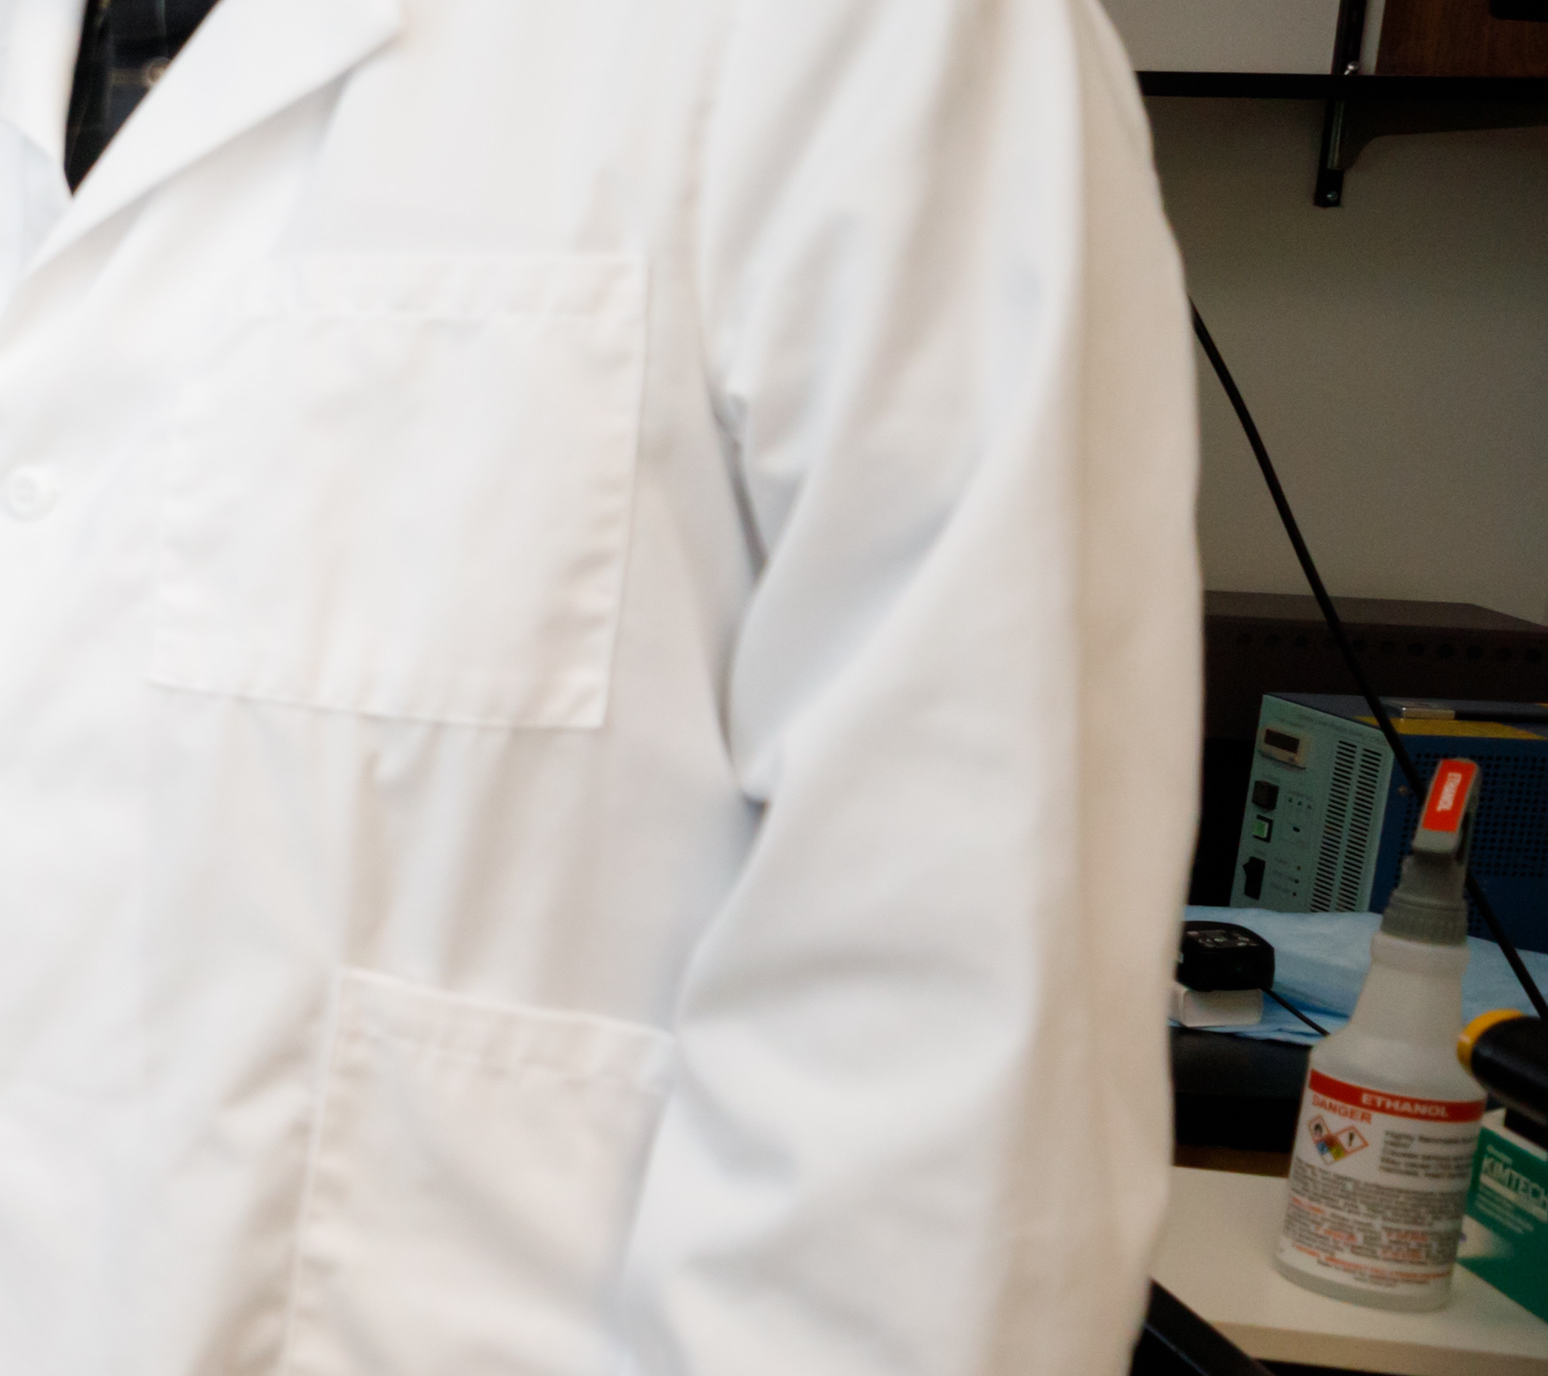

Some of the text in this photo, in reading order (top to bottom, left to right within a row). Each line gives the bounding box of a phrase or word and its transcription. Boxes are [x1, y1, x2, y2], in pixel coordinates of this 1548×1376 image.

[1437, 772, 1462, 812] ETHANOL
[1312, 1093, 1372, 1124] DANGER
[1361, 1092, 1450, 1119] ETHANOL
